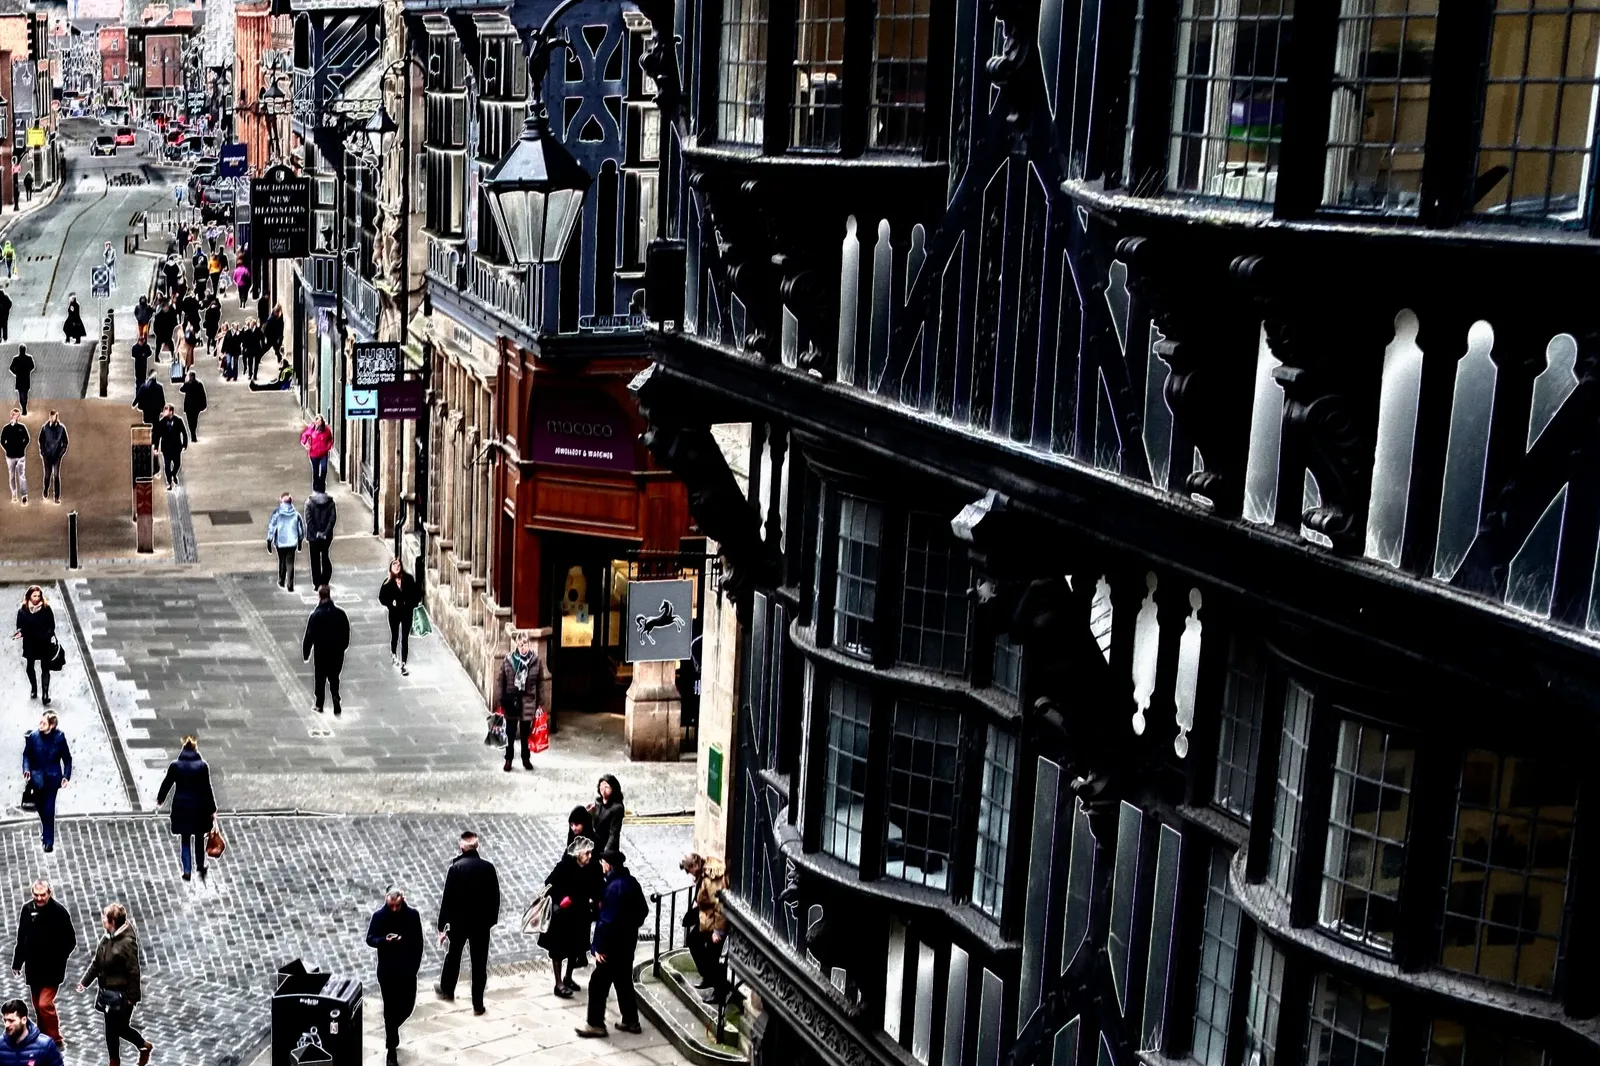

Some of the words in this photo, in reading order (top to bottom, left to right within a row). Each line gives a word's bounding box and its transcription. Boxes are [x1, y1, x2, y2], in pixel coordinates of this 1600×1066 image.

[255, 183, 306, 192] MACDONALD
[269, 195, 291, 204] NEW
[254, 205, 306, 215] BLOSSOMS
[263, 216, 296, 225] HOTEL
[580, 317, 592, 328] ST
[596, 316, 621, 328] JOHN
[357, 348, 396, 360] LUSH
[546, 420, 613, 438] mococo
